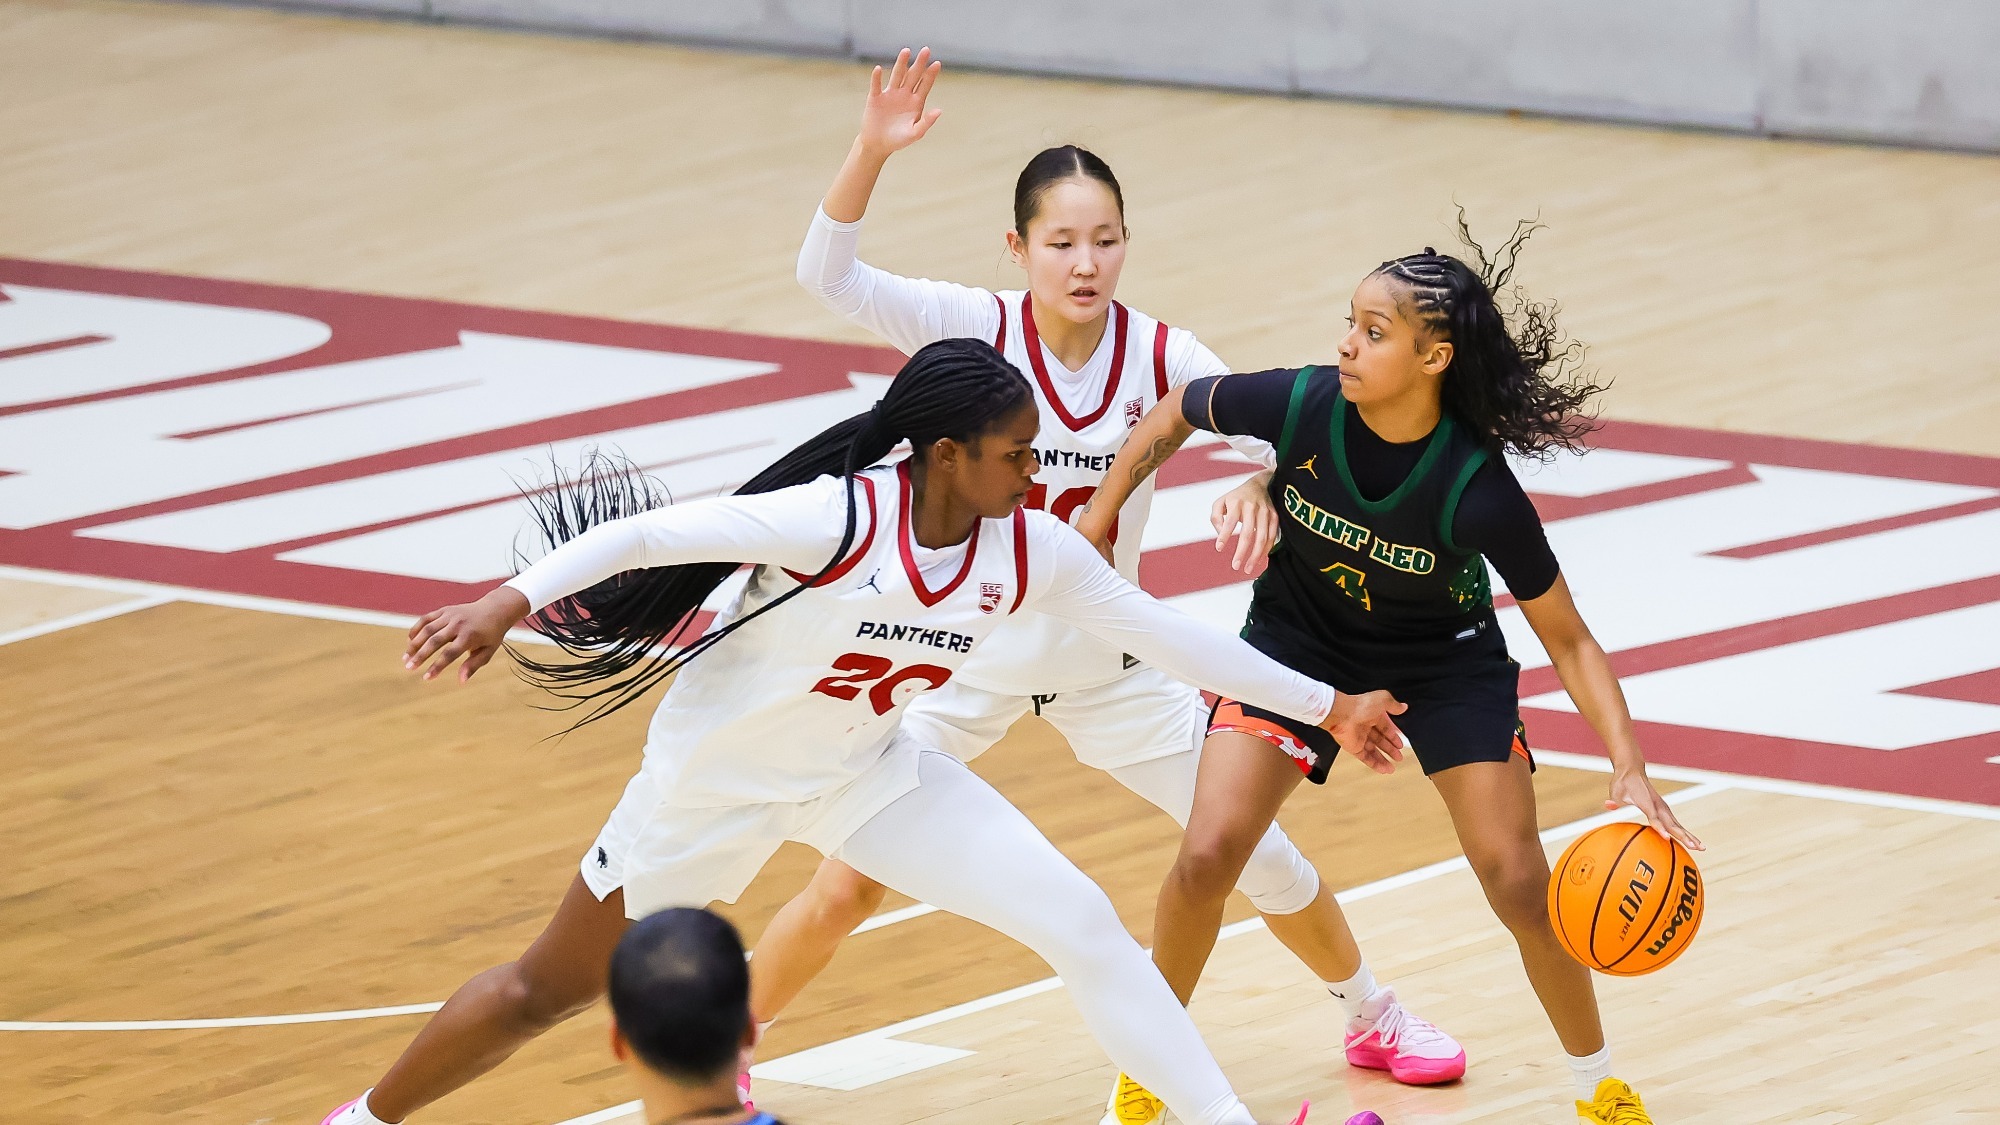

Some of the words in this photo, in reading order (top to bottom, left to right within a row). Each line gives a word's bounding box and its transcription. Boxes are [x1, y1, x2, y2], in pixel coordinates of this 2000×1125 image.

[1284, 484, 1371, 551] SAINT
[1369, 536, 1436, 575] LEO
[982, 584, 1002, 594] SSC
[1319, 562, 1371, 611] 4
[855, 621, 974, 653] PANTHERS
[808, 653, 953, 716] 20
[1618, 859, 1655, 923] EVO
[1645, 865, 1698, 956] Wilson
